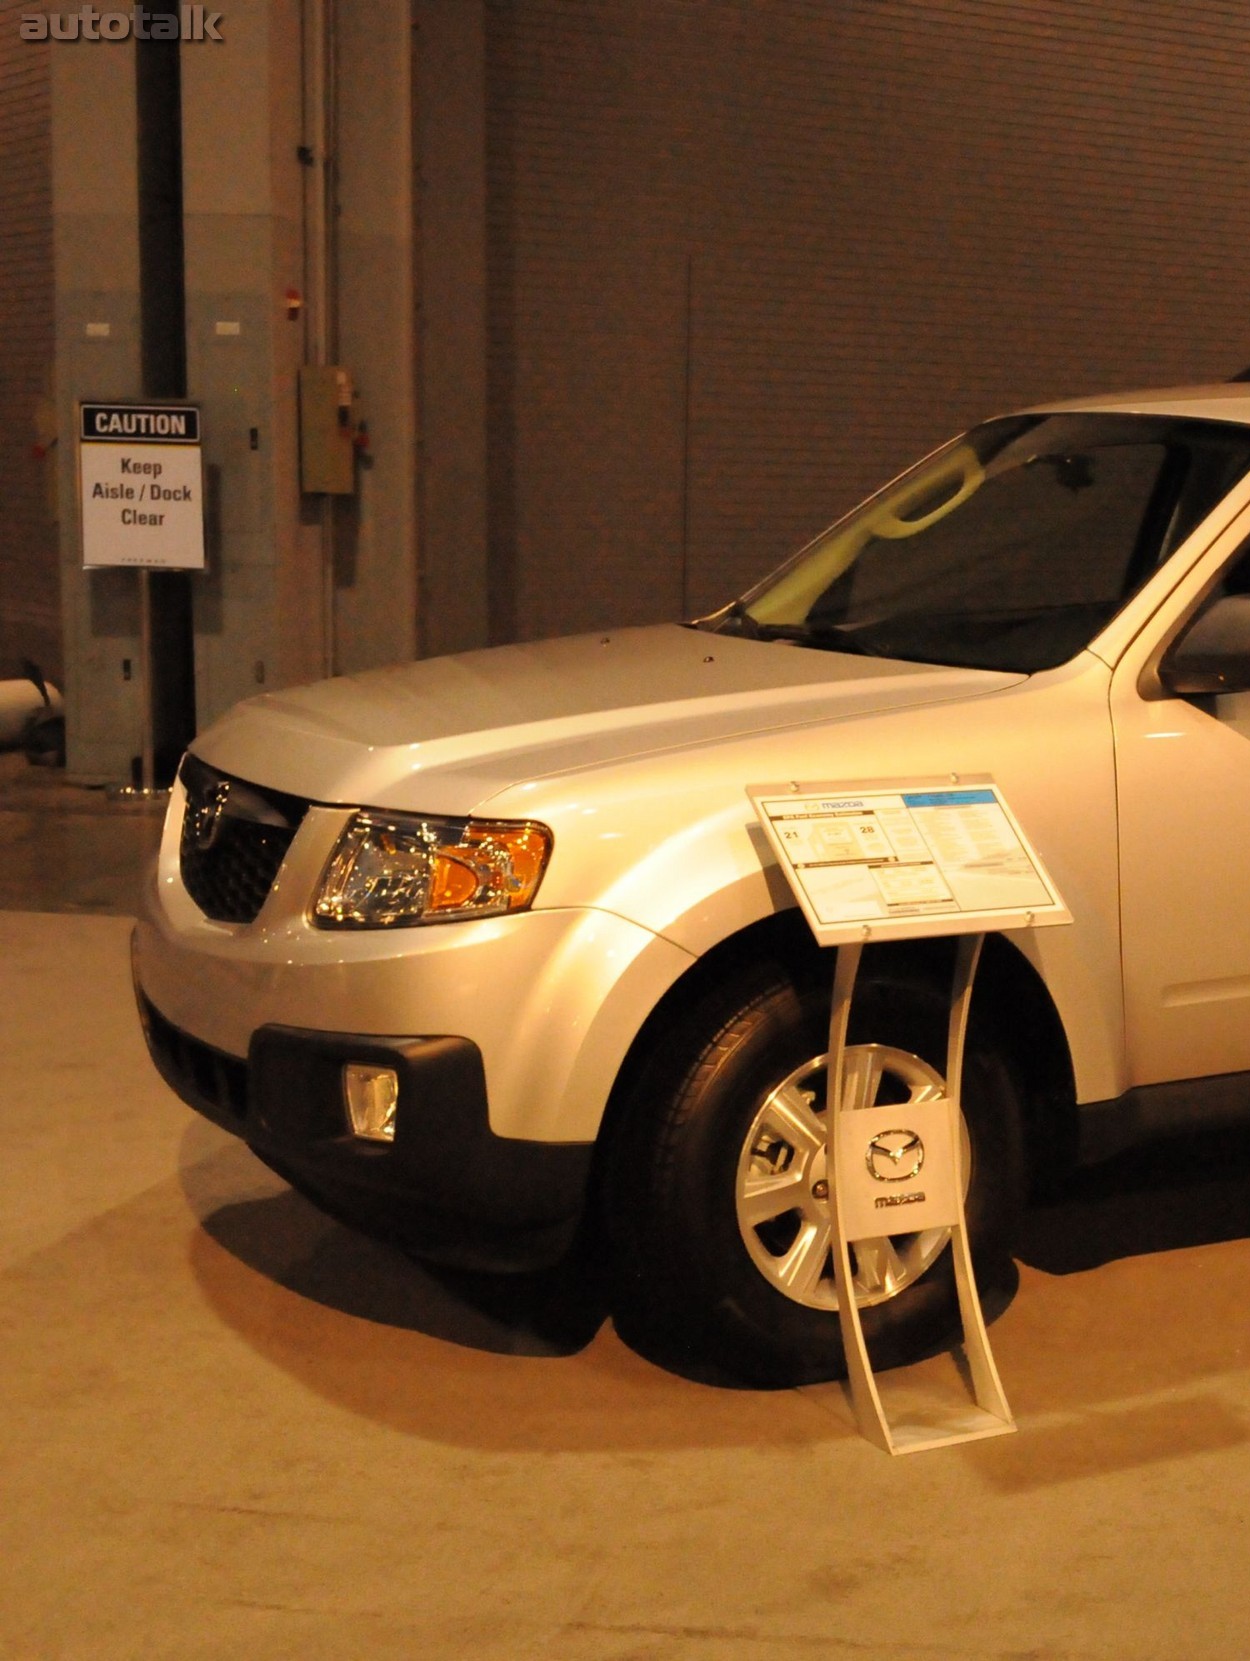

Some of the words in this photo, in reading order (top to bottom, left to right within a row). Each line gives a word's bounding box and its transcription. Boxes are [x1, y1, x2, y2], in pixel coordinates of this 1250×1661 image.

[95, 413, 185, 434] CAUTION
[121, 457, 163, 479] Keep
[92, 483, 135, 499] Aisle
[150, 484, 192, 501] Dock
[121, 508, 165, 526] Clear
[821, 800, 864, 809] mazda
[784, 831, 799, 839] 21
[859, 825, 875, 834] 28
[875, 1191, 925, 1208] mazda
